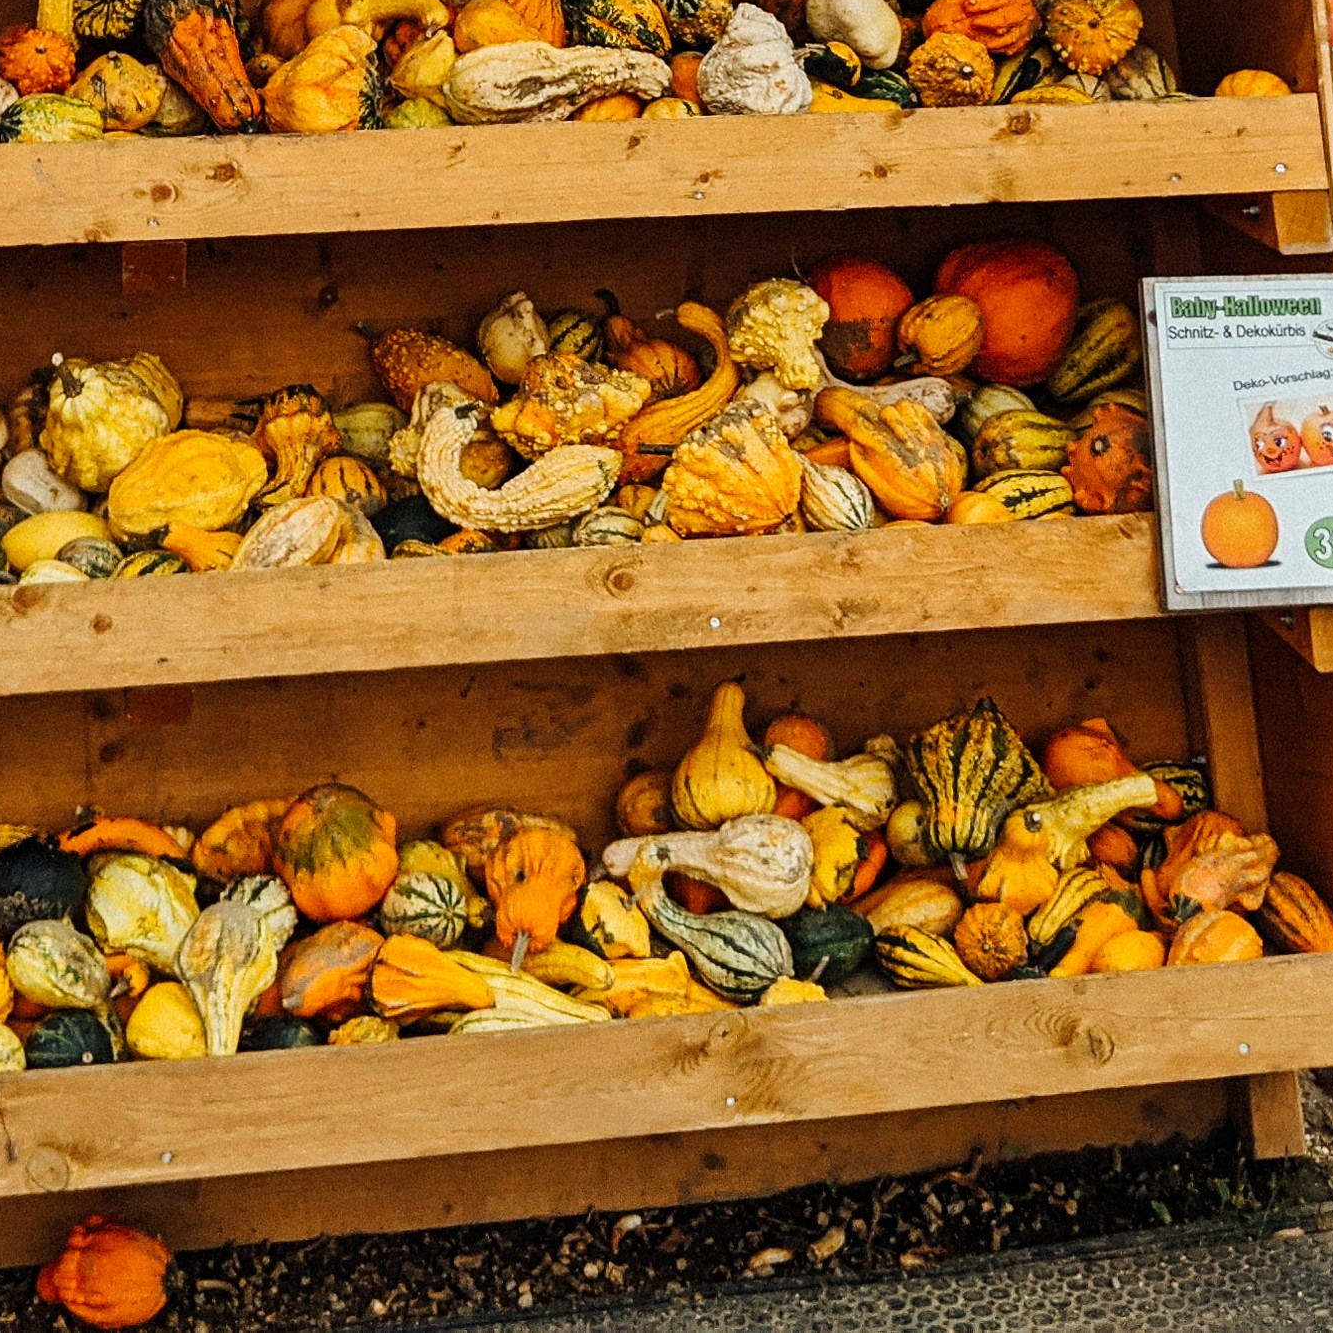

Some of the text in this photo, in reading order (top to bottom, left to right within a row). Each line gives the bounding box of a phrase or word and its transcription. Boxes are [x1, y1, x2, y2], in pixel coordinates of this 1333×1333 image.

[1169, 295, 1322, 320] Baby-Halloween
[1168, 325, 1220, 340] Schnitz-
[1223, 326, 1233, 338] &
[1236, 324, 1306, 338] Dekokürbis
[1233, 368, 1333, 392] Deko-Vorschlag:
